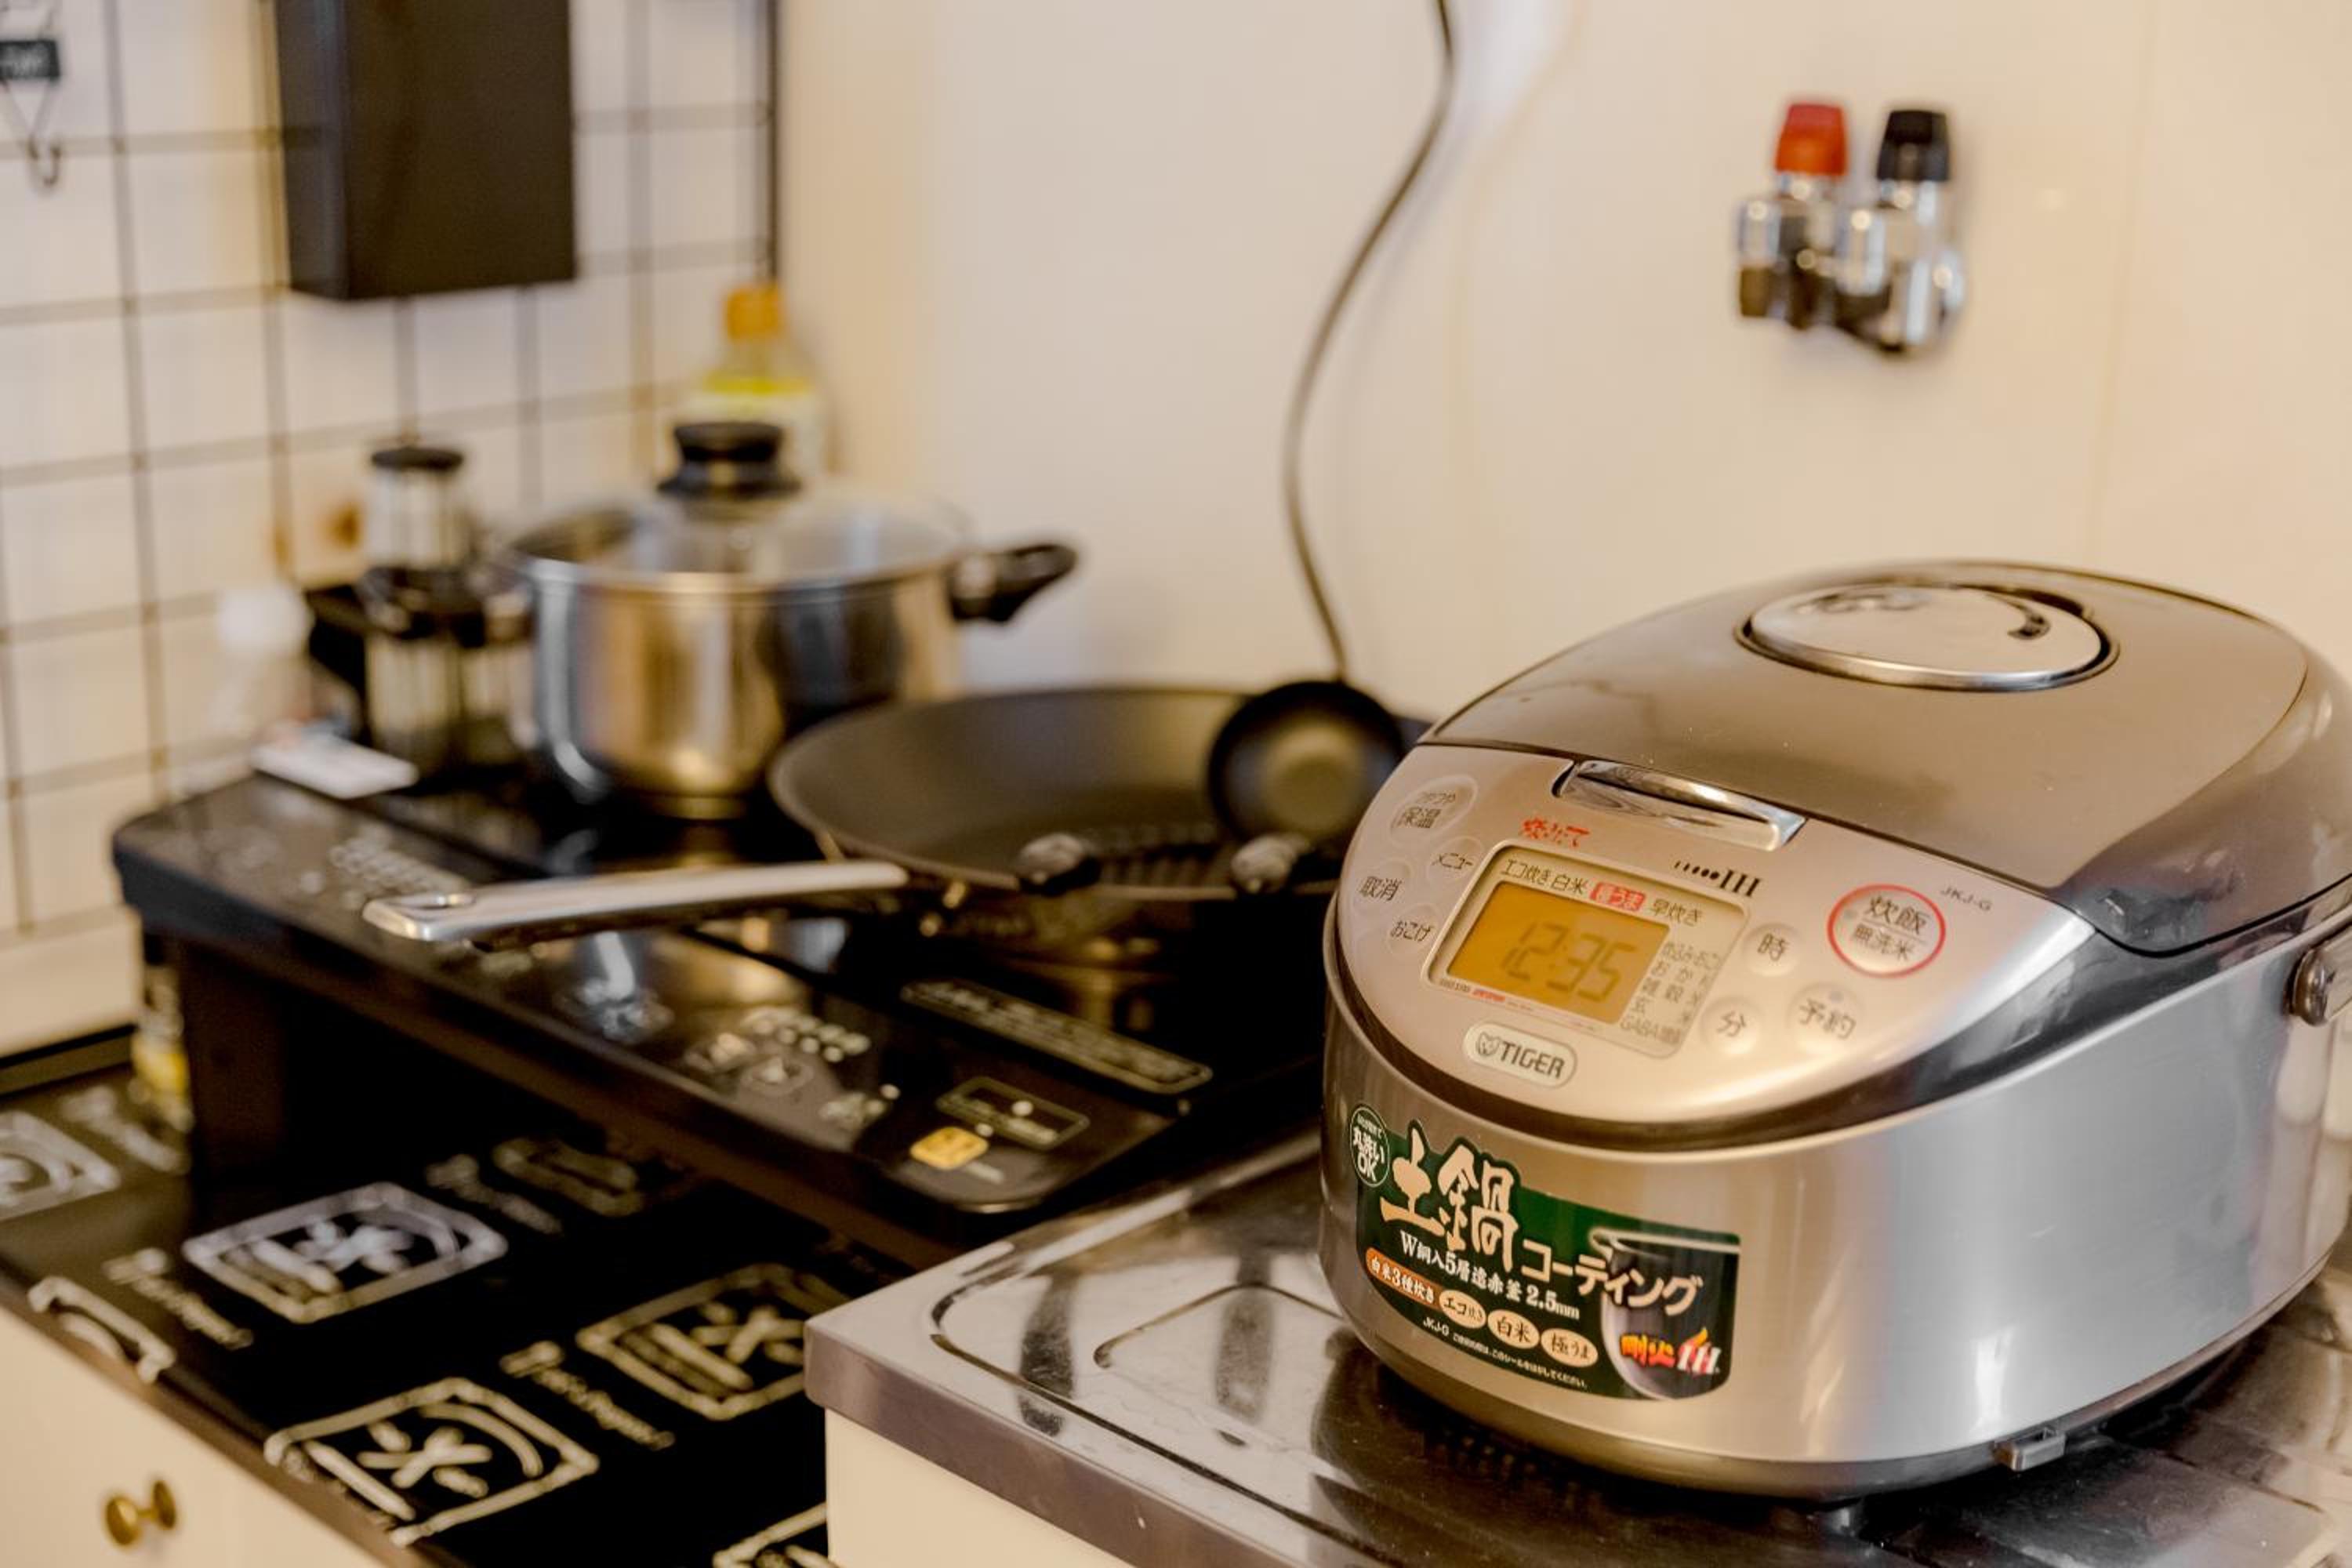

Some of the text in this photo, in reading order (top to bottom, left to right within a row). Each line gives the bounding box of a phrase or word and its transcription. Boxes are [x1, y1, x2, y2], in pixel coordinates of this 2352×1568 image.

[1398, 806, 1441, 829] 保温
[1359, 875, 1403, 902] 取消
[1939, 884, 1994, 913] JKJ-G
[1864, 895, 1930, 936] 炊飯
[1757, 932, 1791, 962] 時
[1853, 924, 1915, 962] 無洗米
[1715, 1011, 1748, 1038] 分
[1798, 998, 1857, 1040] 予約
[1499, 1040, 1566, 1080] TIGER
[1357, 1152, 1377, 1182] OK
[1520, 1238, 1704, 1317] コーティング
[1526, 1283, 1581, 1320] 2.5mm
[1496, 1315, 1532, 1344] 白米
